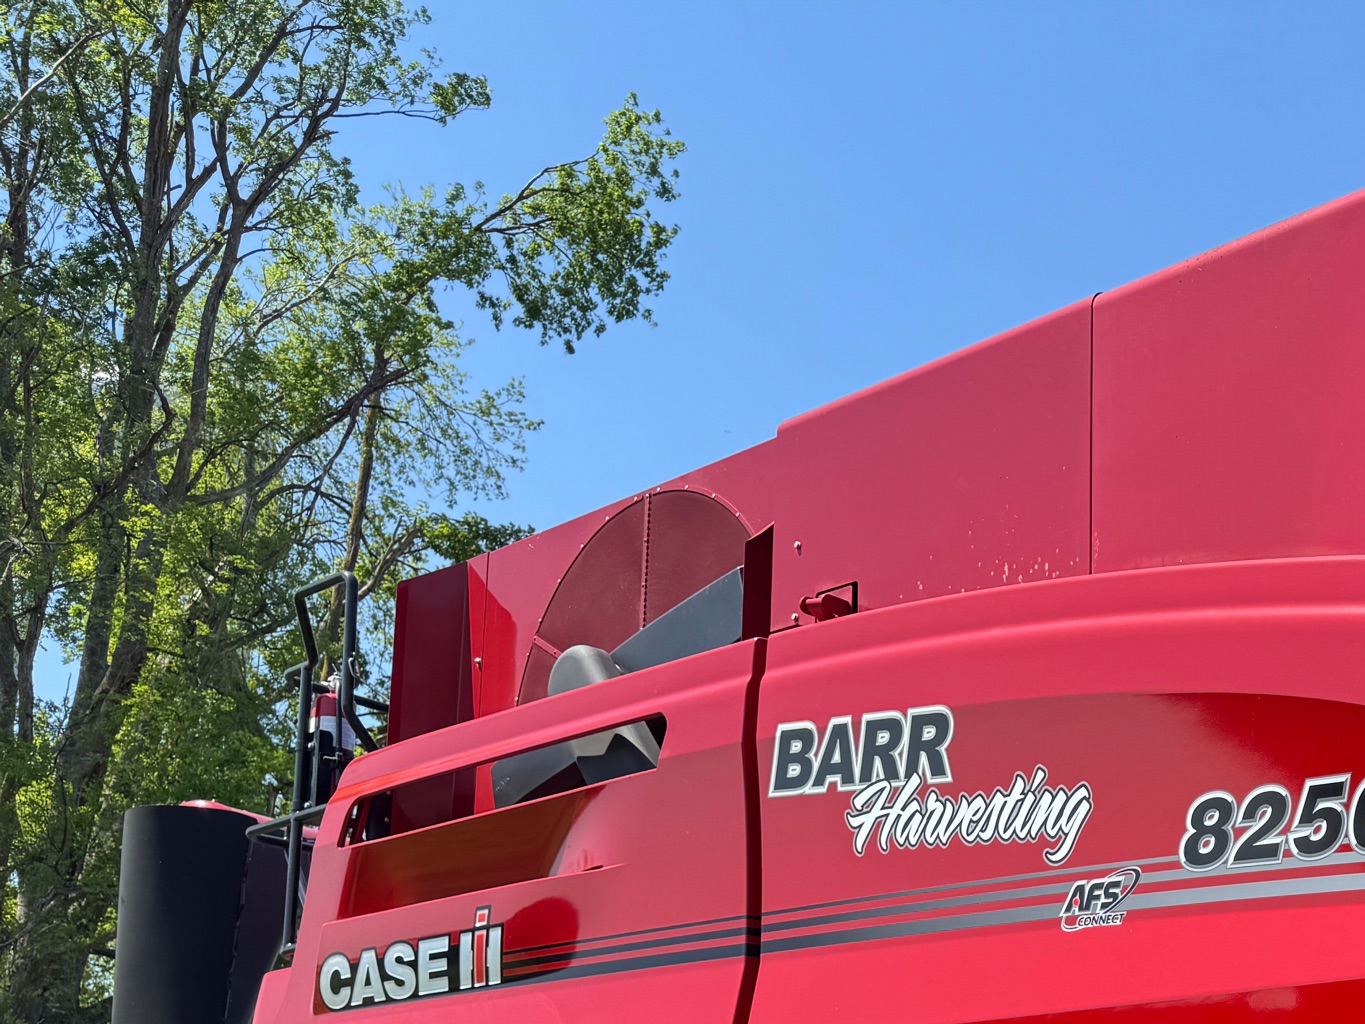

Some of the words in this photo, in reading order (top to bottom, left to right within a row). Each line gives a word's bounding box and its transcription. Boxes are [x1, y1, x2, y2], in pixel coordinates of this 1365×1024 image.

[768, 705, 954, 798] BARR
[846, 763, 1093, 865] Harvesting
[1060, 876, 1126, 916] AFS
[1078, 911, 1126, 927] CONNECT
[317, 933, 450, 1012] CASE
[458, 905, 504, 990] IH
